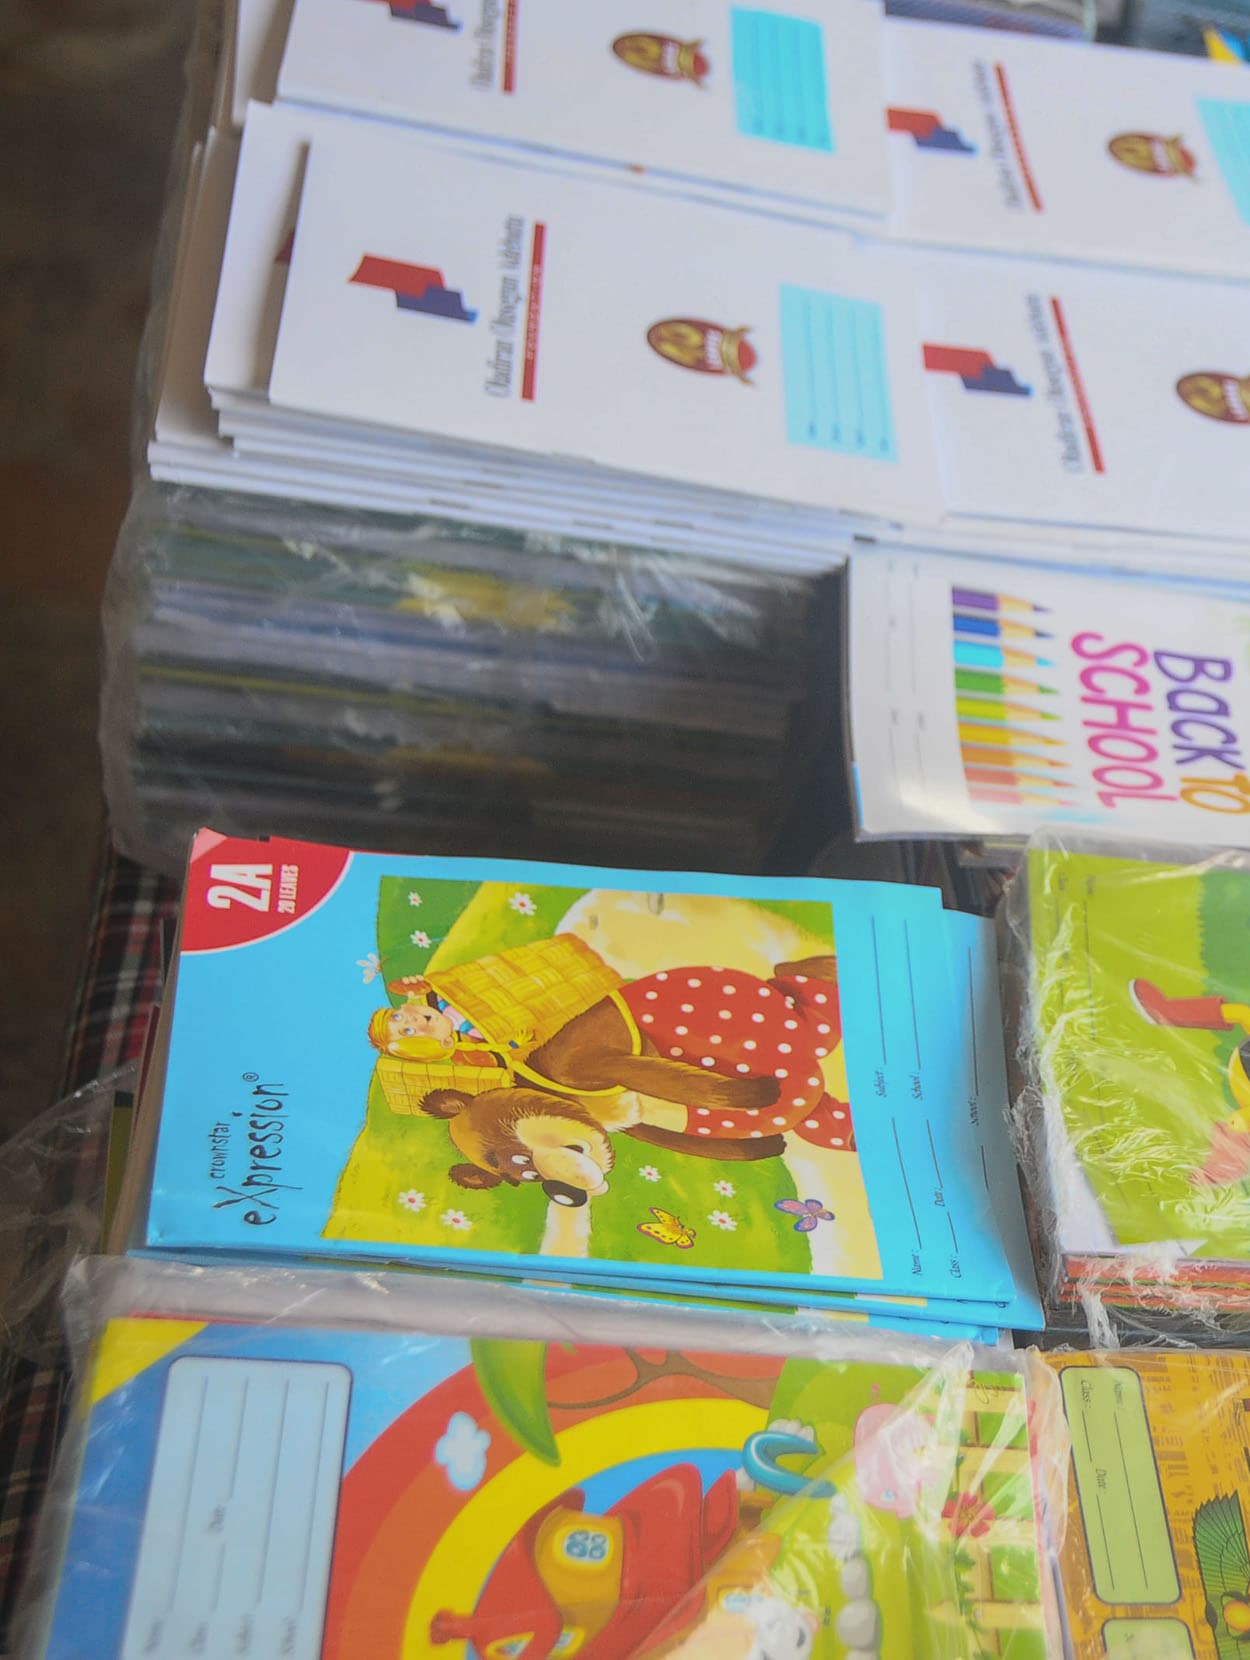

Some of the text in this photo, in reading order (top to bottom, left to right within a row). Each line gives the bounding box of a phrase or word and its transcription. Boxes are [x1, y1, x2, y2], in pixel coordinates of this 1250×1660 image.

[1071, 631, 1180, 809] SCHOOL
[207, 864, 273, 912] 2A
[279, 864, 299, 900] LEAVES
[208, 1121, 231, 1180] crownstar
